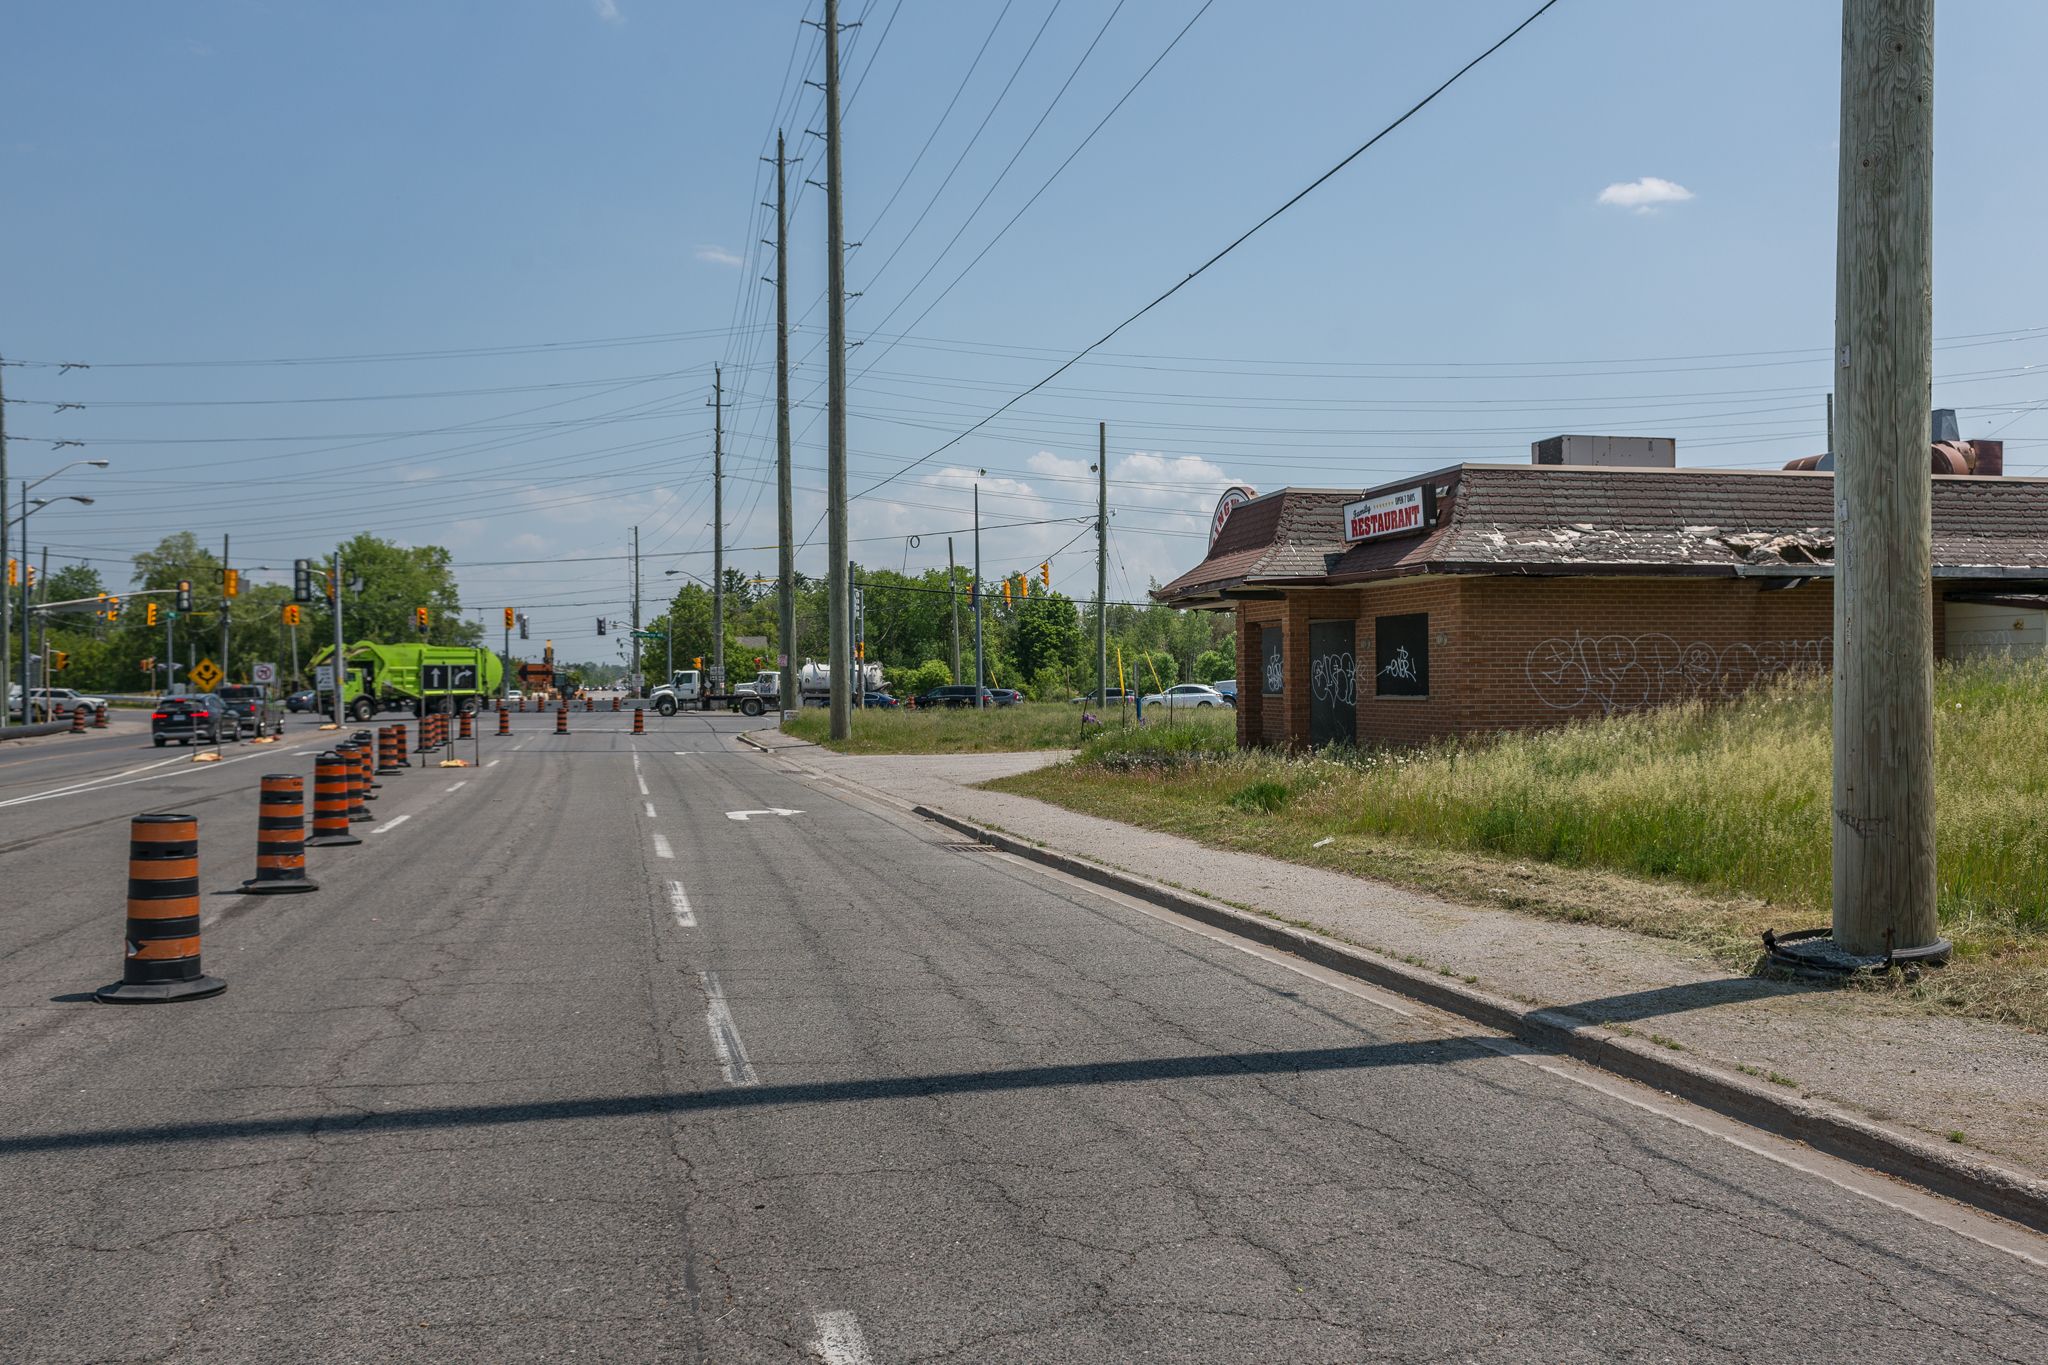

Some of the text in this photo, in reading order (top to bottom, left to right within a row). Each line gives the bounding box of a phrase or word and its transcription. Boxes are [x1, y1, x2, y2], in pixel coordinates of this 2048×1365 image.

[1395, 497, 1404, 505] OPEN
[1407, 493, 1416, 503] DAYS
[1353, 504, 1371, 518] Family
[1351, 505, 1420, 537] RESTAURANT
